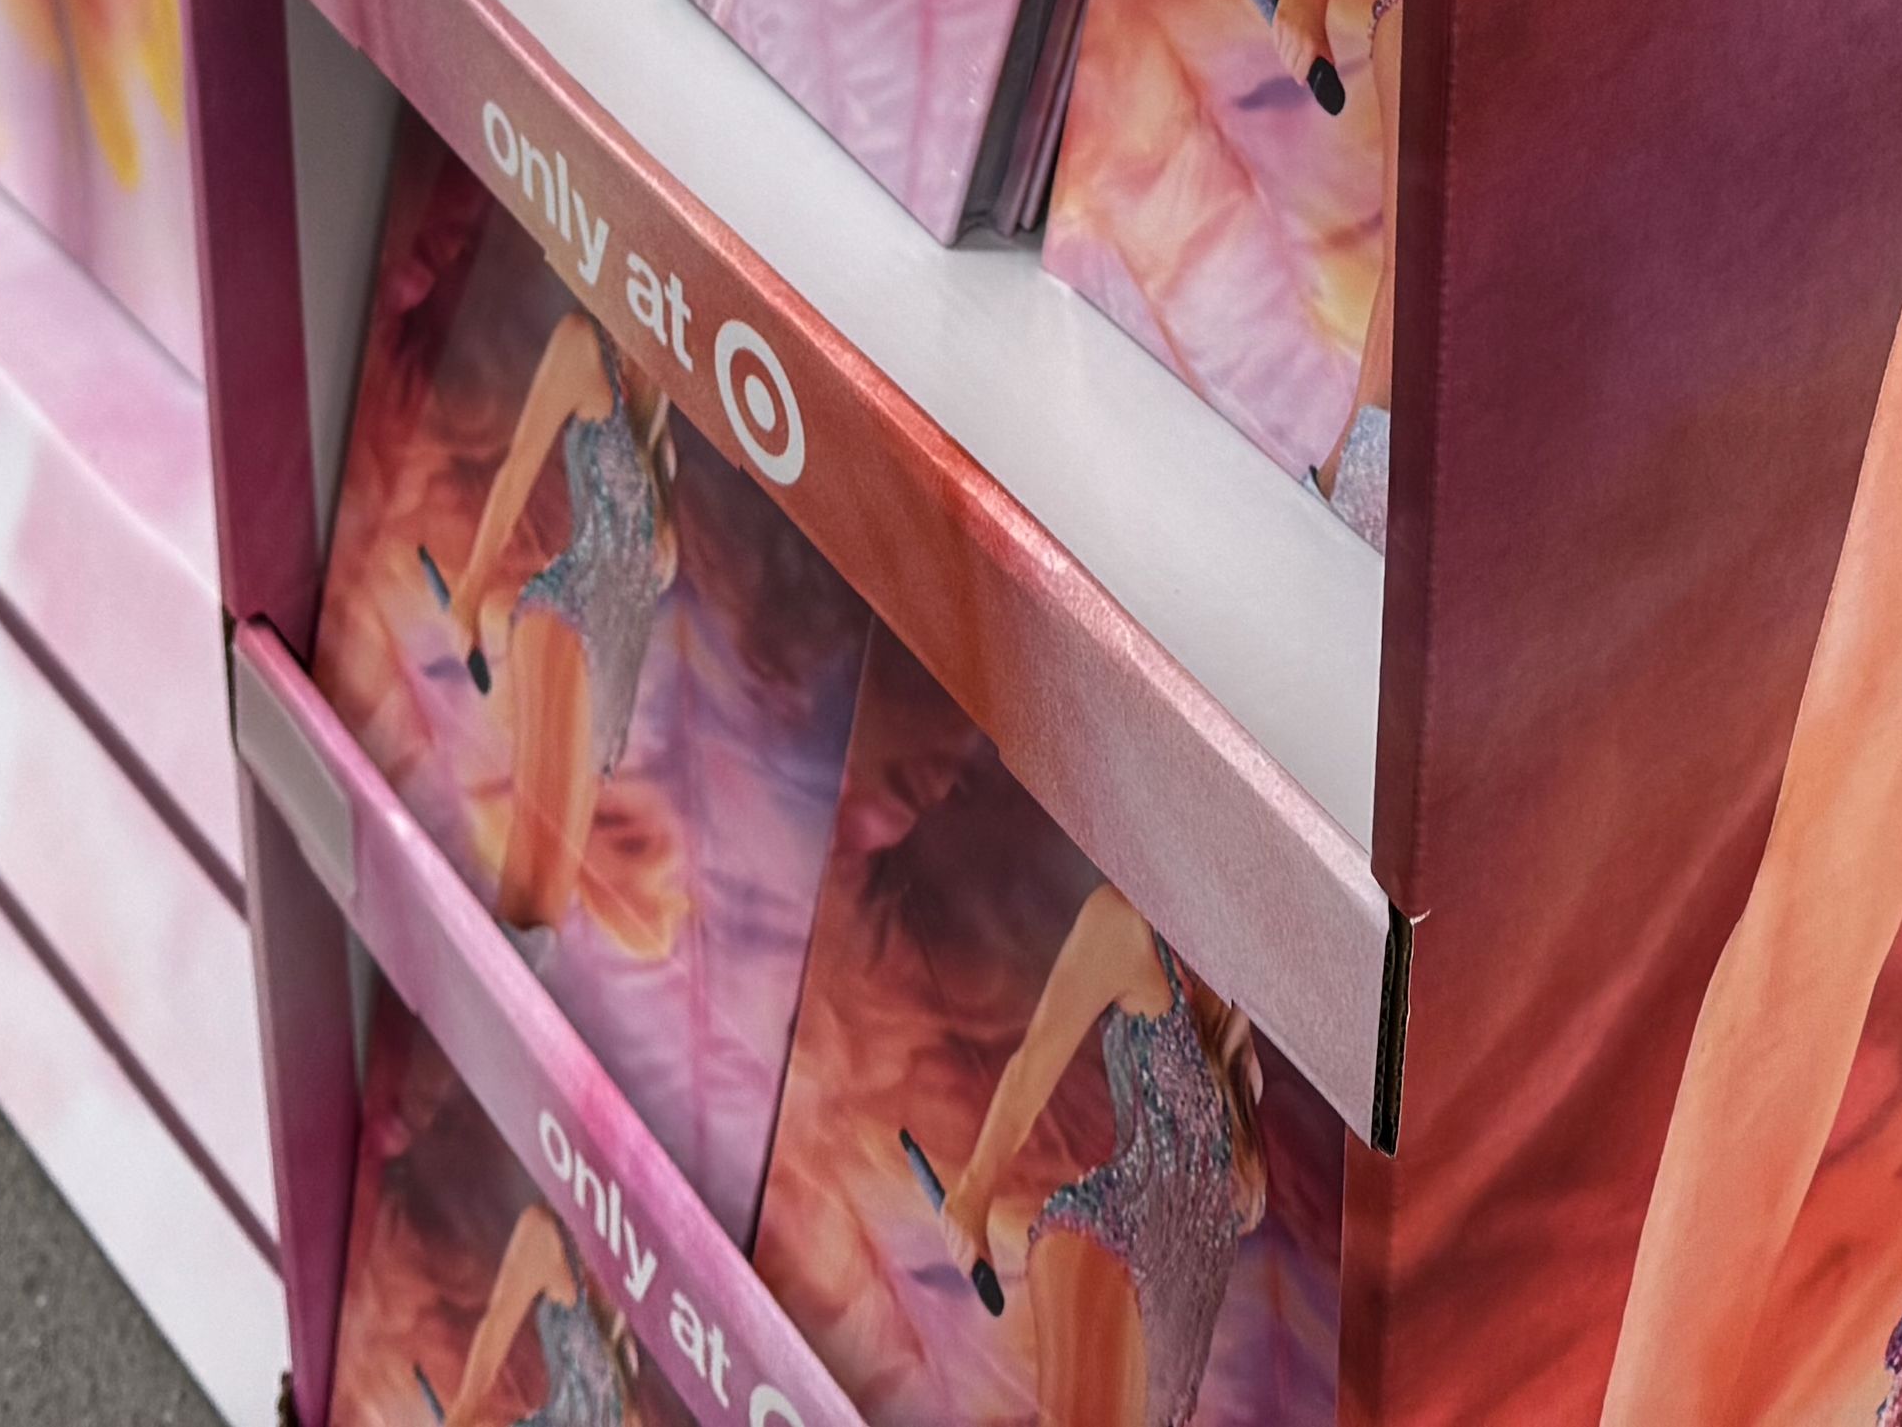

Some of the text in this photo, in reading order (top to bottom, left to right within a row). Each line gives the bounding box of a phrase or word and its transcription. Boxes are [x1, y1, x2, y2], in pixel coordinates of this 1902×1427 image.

[482, 100, 694, 373] only at
[538, 1110, 731, 1409] only at
